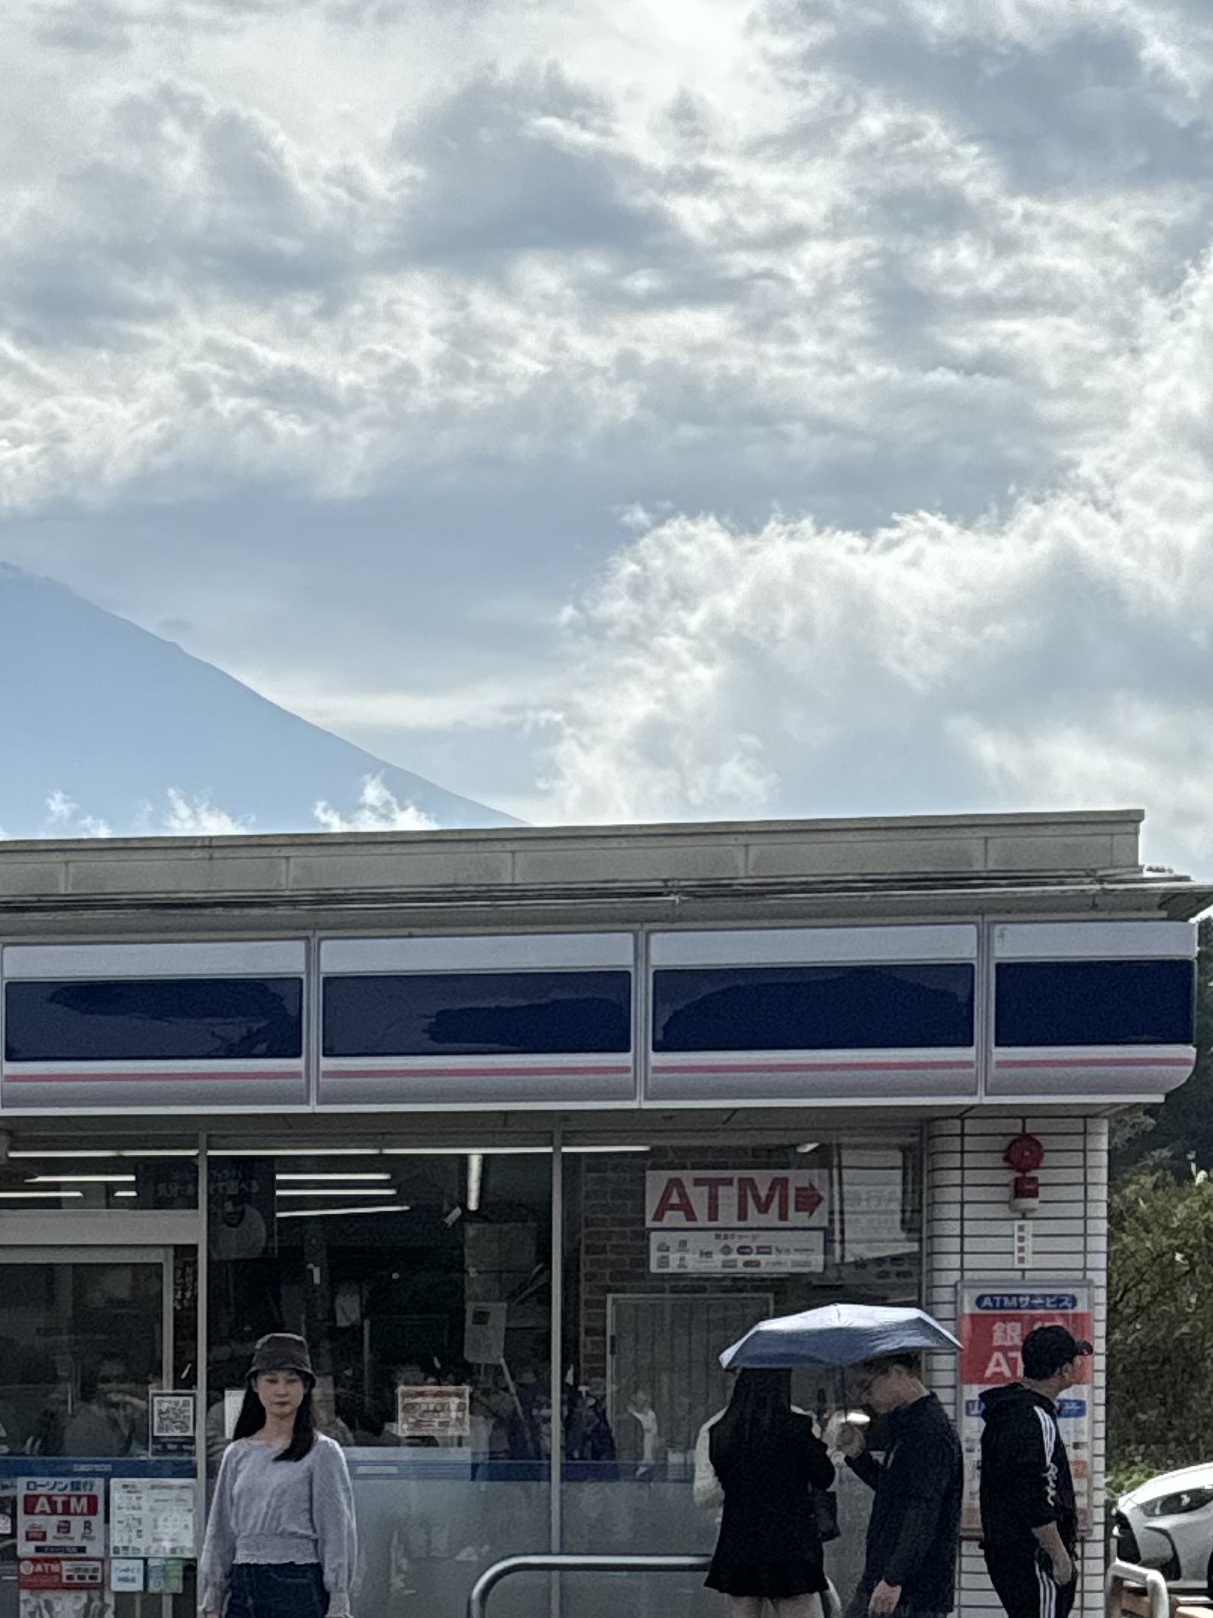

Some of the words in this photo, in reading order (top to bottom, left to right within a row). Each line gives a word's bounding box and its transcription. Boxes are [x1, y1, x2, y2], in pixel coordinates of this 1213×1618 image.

[651, 1177, 789, 1222] ATM
[981, 1295, 1070, 1309] ATMサービス
[26, 1480, 95, 1492] ローソン銀行
[34, 1496, 88, 1514] ATM
